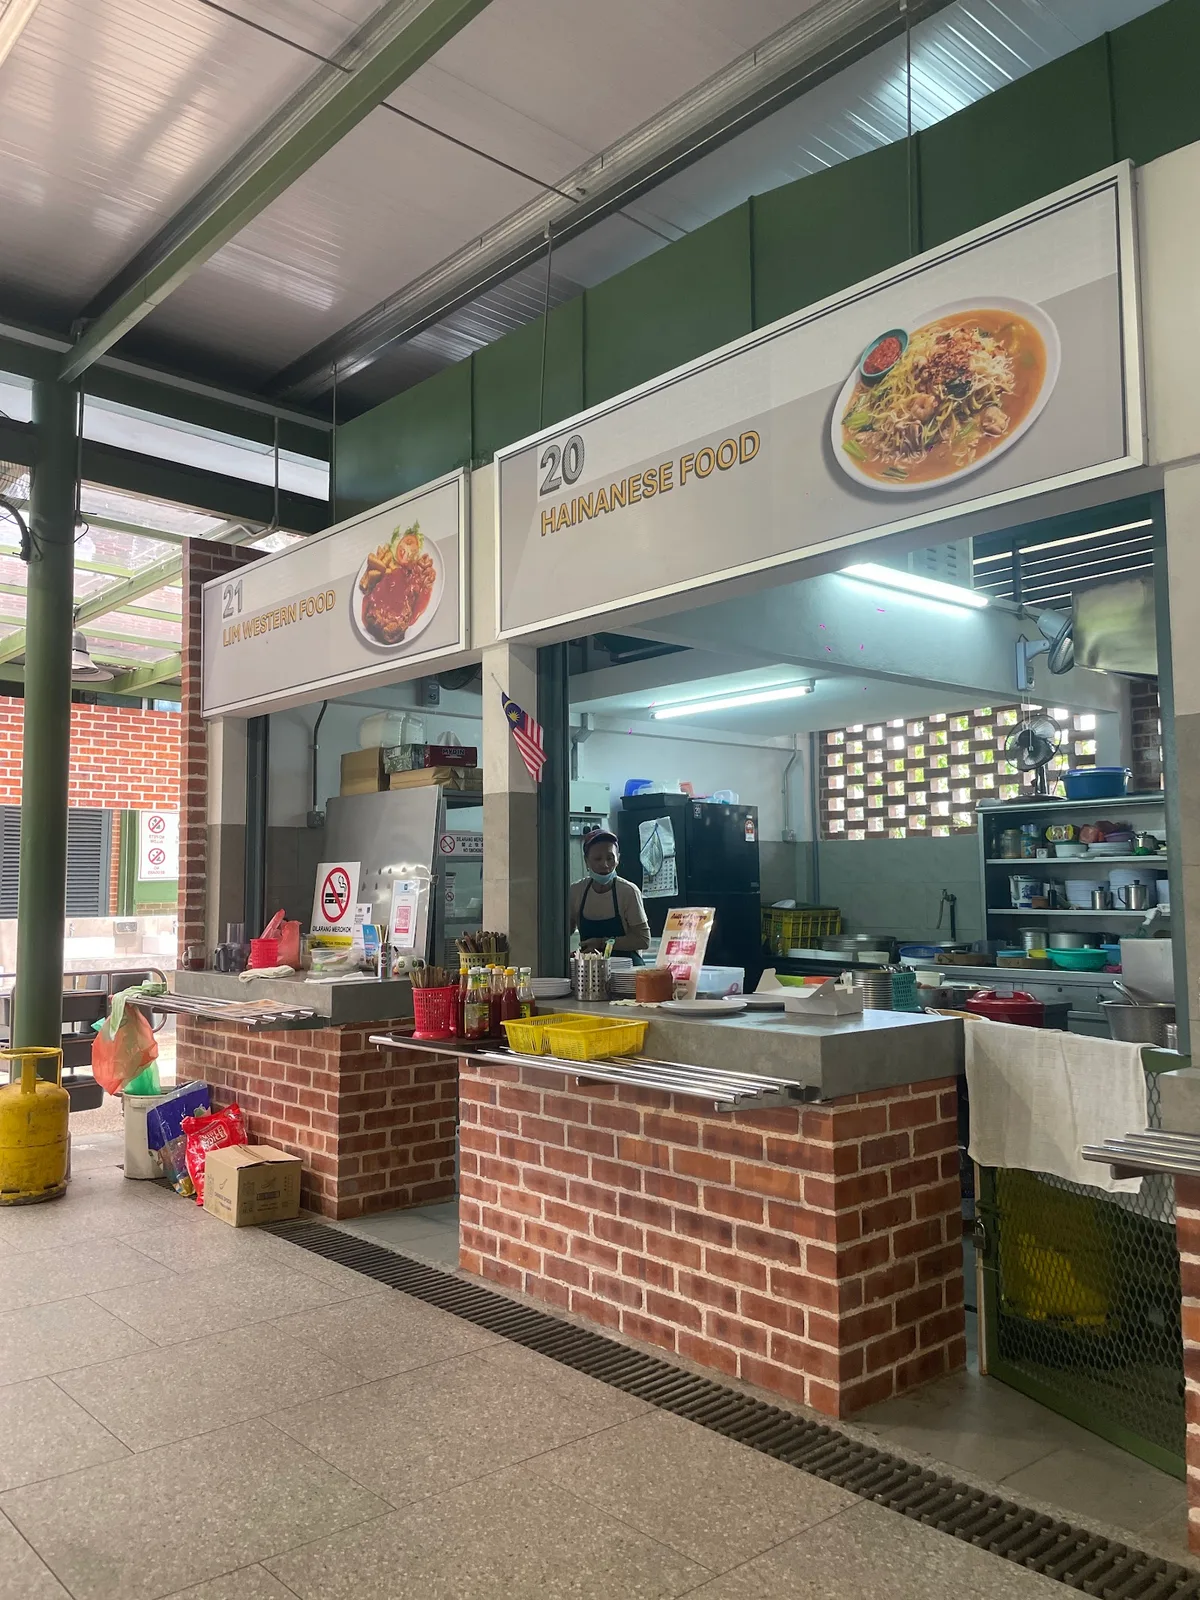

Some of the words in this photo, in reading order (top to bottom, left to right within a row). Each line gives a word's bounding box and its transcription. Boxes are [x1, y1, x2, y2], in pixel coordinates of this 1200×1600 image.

[539, 434, 585, 497] 20
[541, 461, 674, 537] HAINANESE
[680, 430, 761, 487] FOOD
[223, 579, 243, 619] 21
[223, 623, 241, 647] LIM
[242, 602, 297, 640] WESTERN
[299, 589, 336, 621] FOOD
[442, 747, 466, 756] MYDIN
[312, 925, 331, 933] DILARANG
